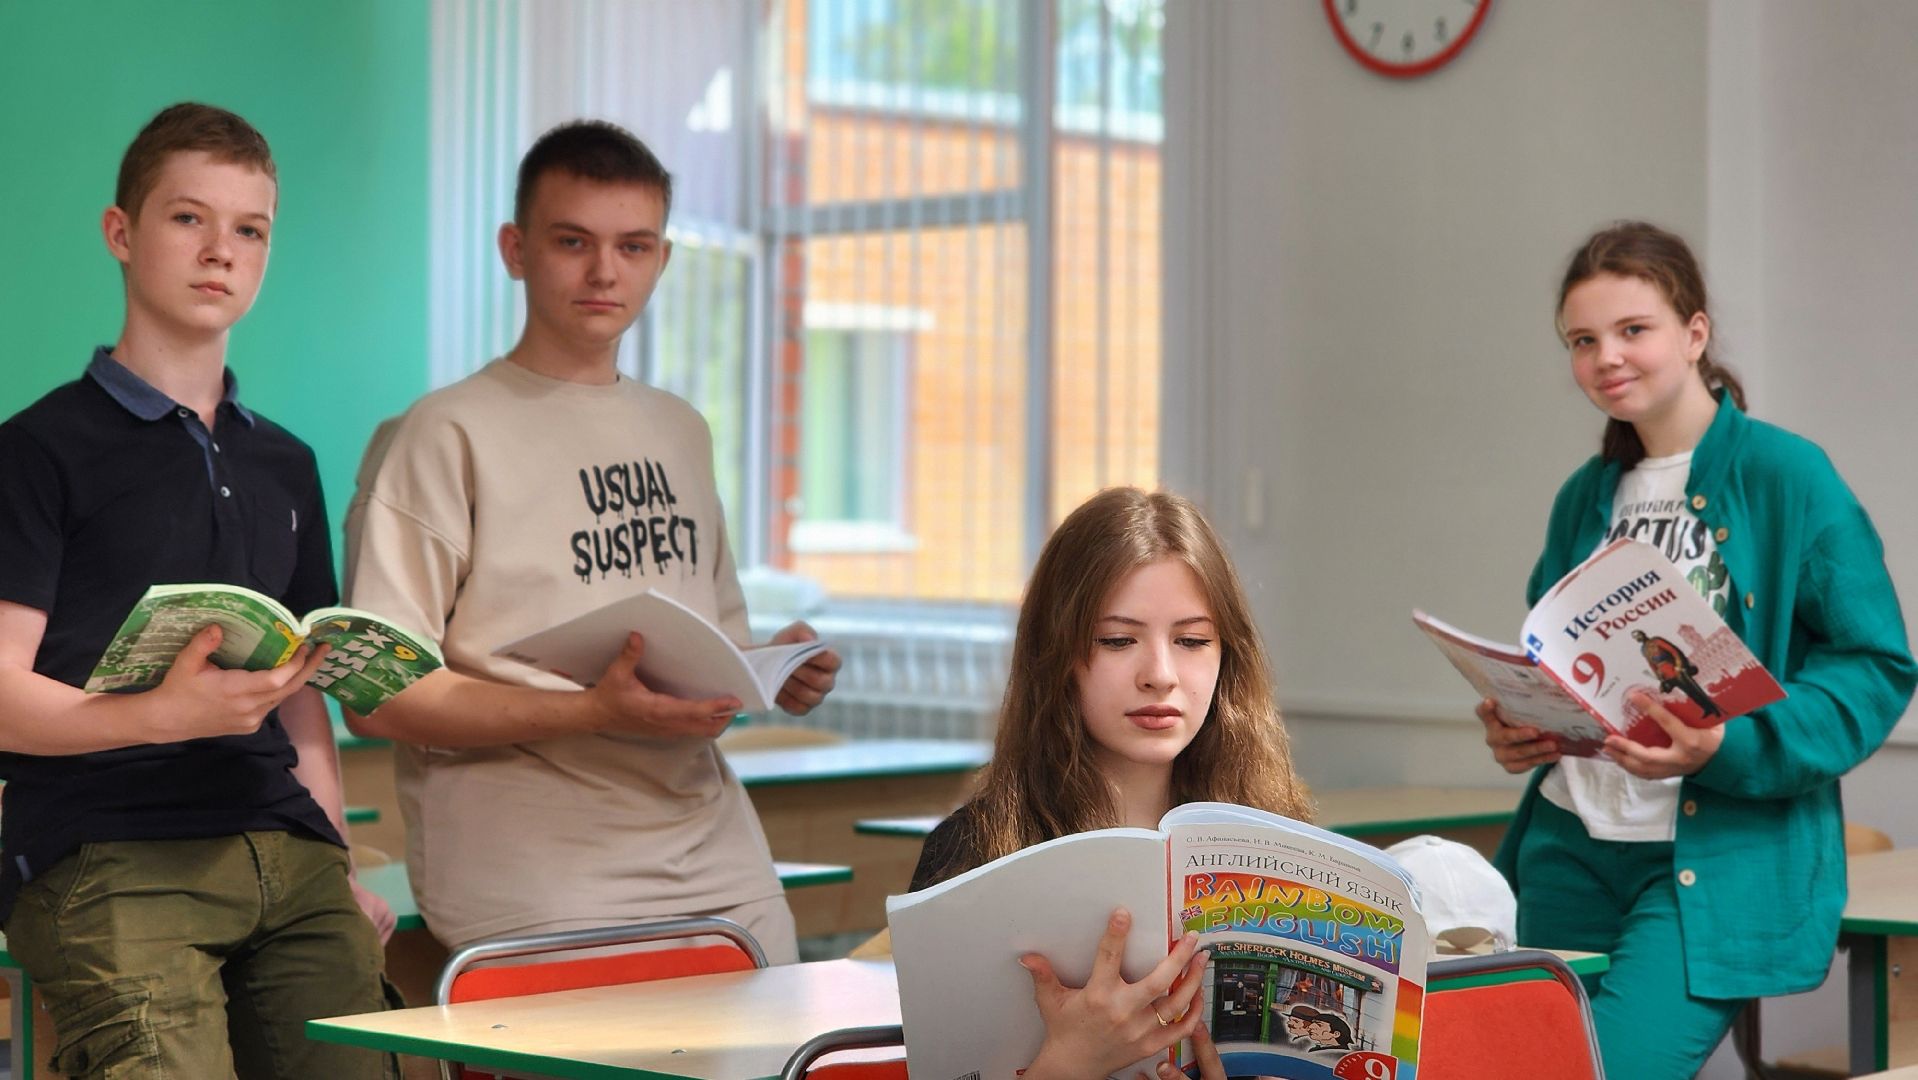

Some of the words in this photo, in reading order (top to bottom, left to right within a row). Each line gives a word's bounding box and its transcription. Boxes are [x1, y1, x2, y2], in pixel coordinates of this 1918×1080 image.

[1369, 22, 1385, 49] 7
[579, 457, 676, 524] USUAL
[571, 515, 697, 584] SUSPECT
[1563, 569, 1661, 641] История
[1593, 588, 1678, 641] России
[308, 628, 396, 689] ХИМИЯ
[393, 644, 419, 662] 9
[1571, 652, 1605, 698] 9
[1186, 853, 1340, 888] АНГЛИЙСКИЙ
[1346, 880, 1404, 915] ЯЗЫК
[1188, 872, 1405, 939] RAINBOW
[1204, 905, 1397, 964] ENGLISH
[1215, 943, 1231, 951] THE
[1233, 943, 1287, 957] SHERLOCK
[1289, 951, 1331, 969] HOLMES
[1332, 963, 1366, 982] MUSEUM
[1364, 1058, 1391, 1080] 9
